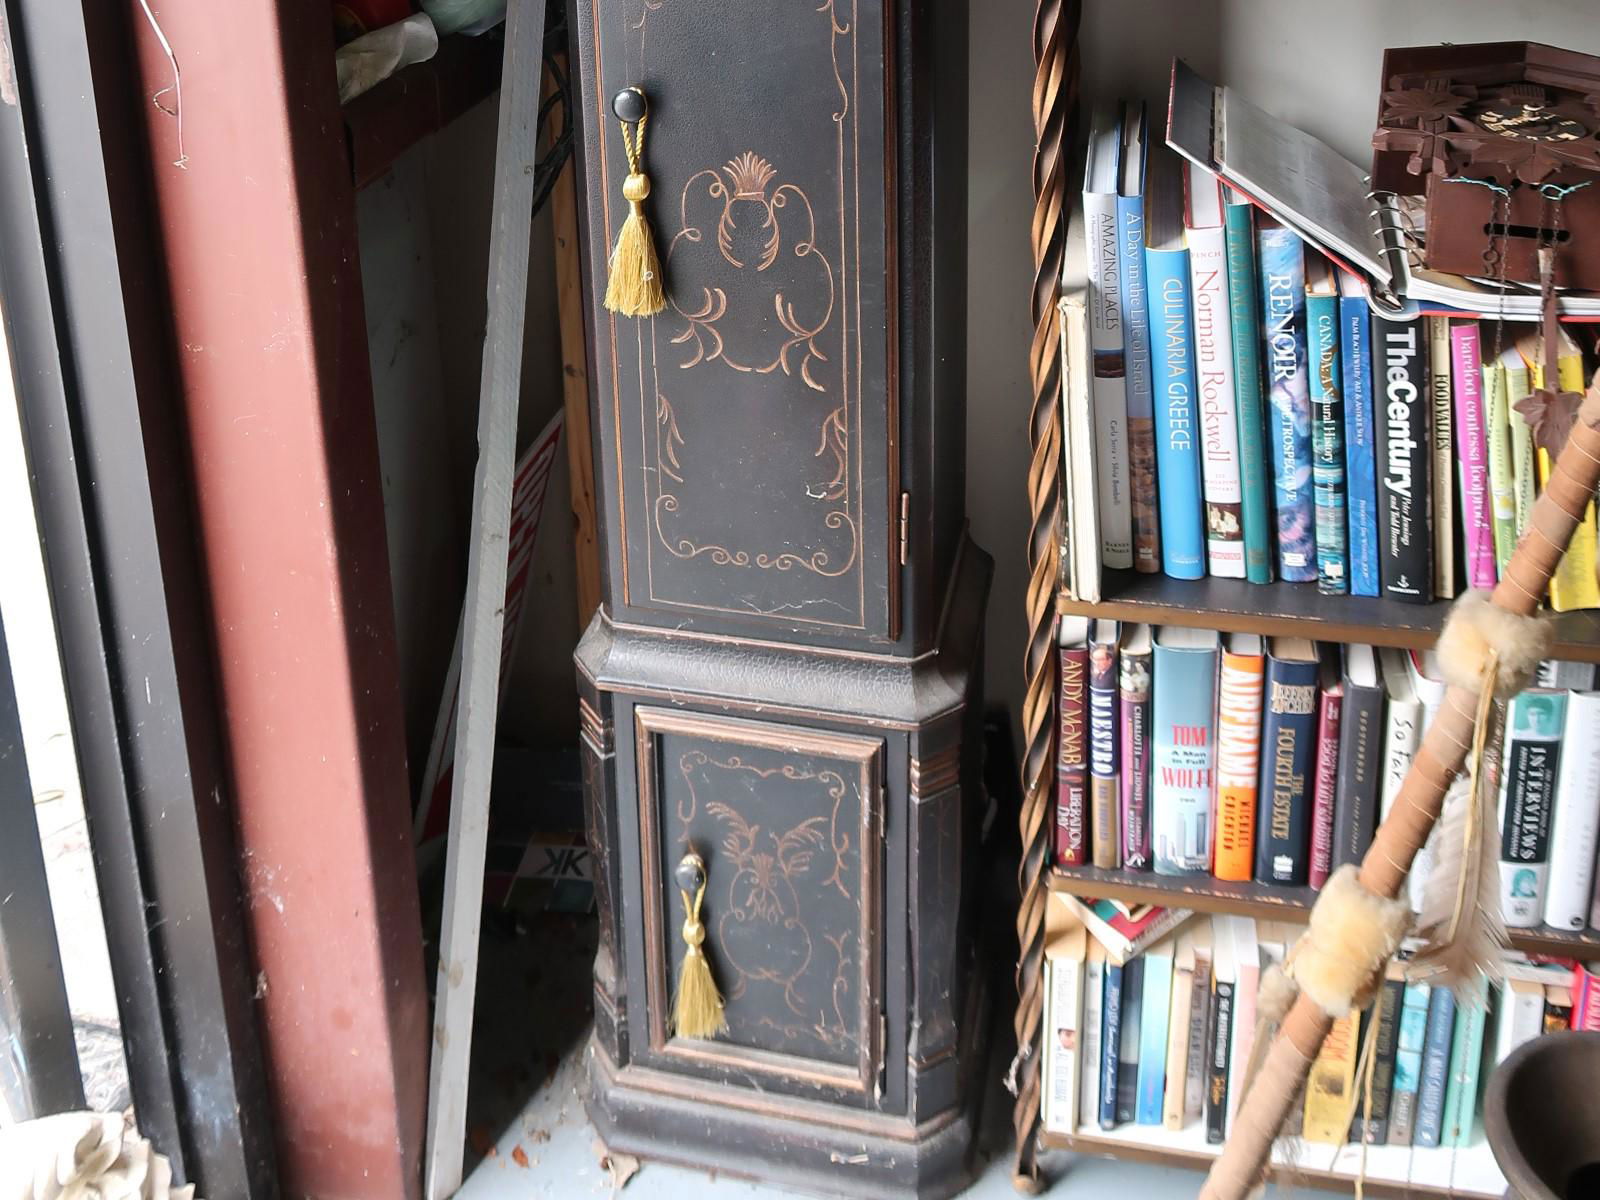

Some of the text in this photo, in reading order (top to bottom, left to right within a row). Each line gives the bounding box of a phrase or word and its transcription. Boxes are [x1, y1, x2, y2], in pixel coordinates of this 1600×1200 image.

[1102, 212, 1121, 330] AMAZING PLACES
[1125, 212, 1148, 395] A Day in the Life of Israel
[1196, 270, 1220, 363] Norman
[1269, 274, 1297, 382] RENOIR
[1351, 316, 1360, 334] PALM
[1163, 278, 1192, 450] CULINARIA GREECE
[1318, 315, 1332, 372] CANADA:
[1321, 387, 1335, 424] Natural
[1322, 375, 1333, 384] A
[1434, 374, 1450, 406] FOOD
[1460, 335, 1482, 462] barefoot contessa
[1202, 371, 1231, 463] Rockwell
[1321, 427, 1336, 464] History
[1434, 408, 1451, 450] VALUES
[1389, 510, 1400, 558] Todd Brewster
[1401, 497, 1412, 546] Peter Jennings
[1061, 659, 1084, 765] ANDY McNAB
[1091, 694, 1113, 774] MAESTRO
[1172, 725, 1208, 746] TOM
[1218, 667, 1263, 789] AIRFRAME
[1393, 716, 1414, 741] So
[1133, 705, 1143, 802] CHARLOTTE LIONEL
[1185, 757, 1206, 765] Full
[1271, 726, 1297, 840] FOURTH ESTATE
[1293, 773, 1305, 796] THE
[1519, 746, 1547, 860] INTERVIEWS
[1057, 806, 1071, 829] DAY
[1068, 787, 1084, 850] LIBERATION
[1224, 794, 1237, 851] CRICHTON
[1239, 799, 1252, 849] MICHAEL
